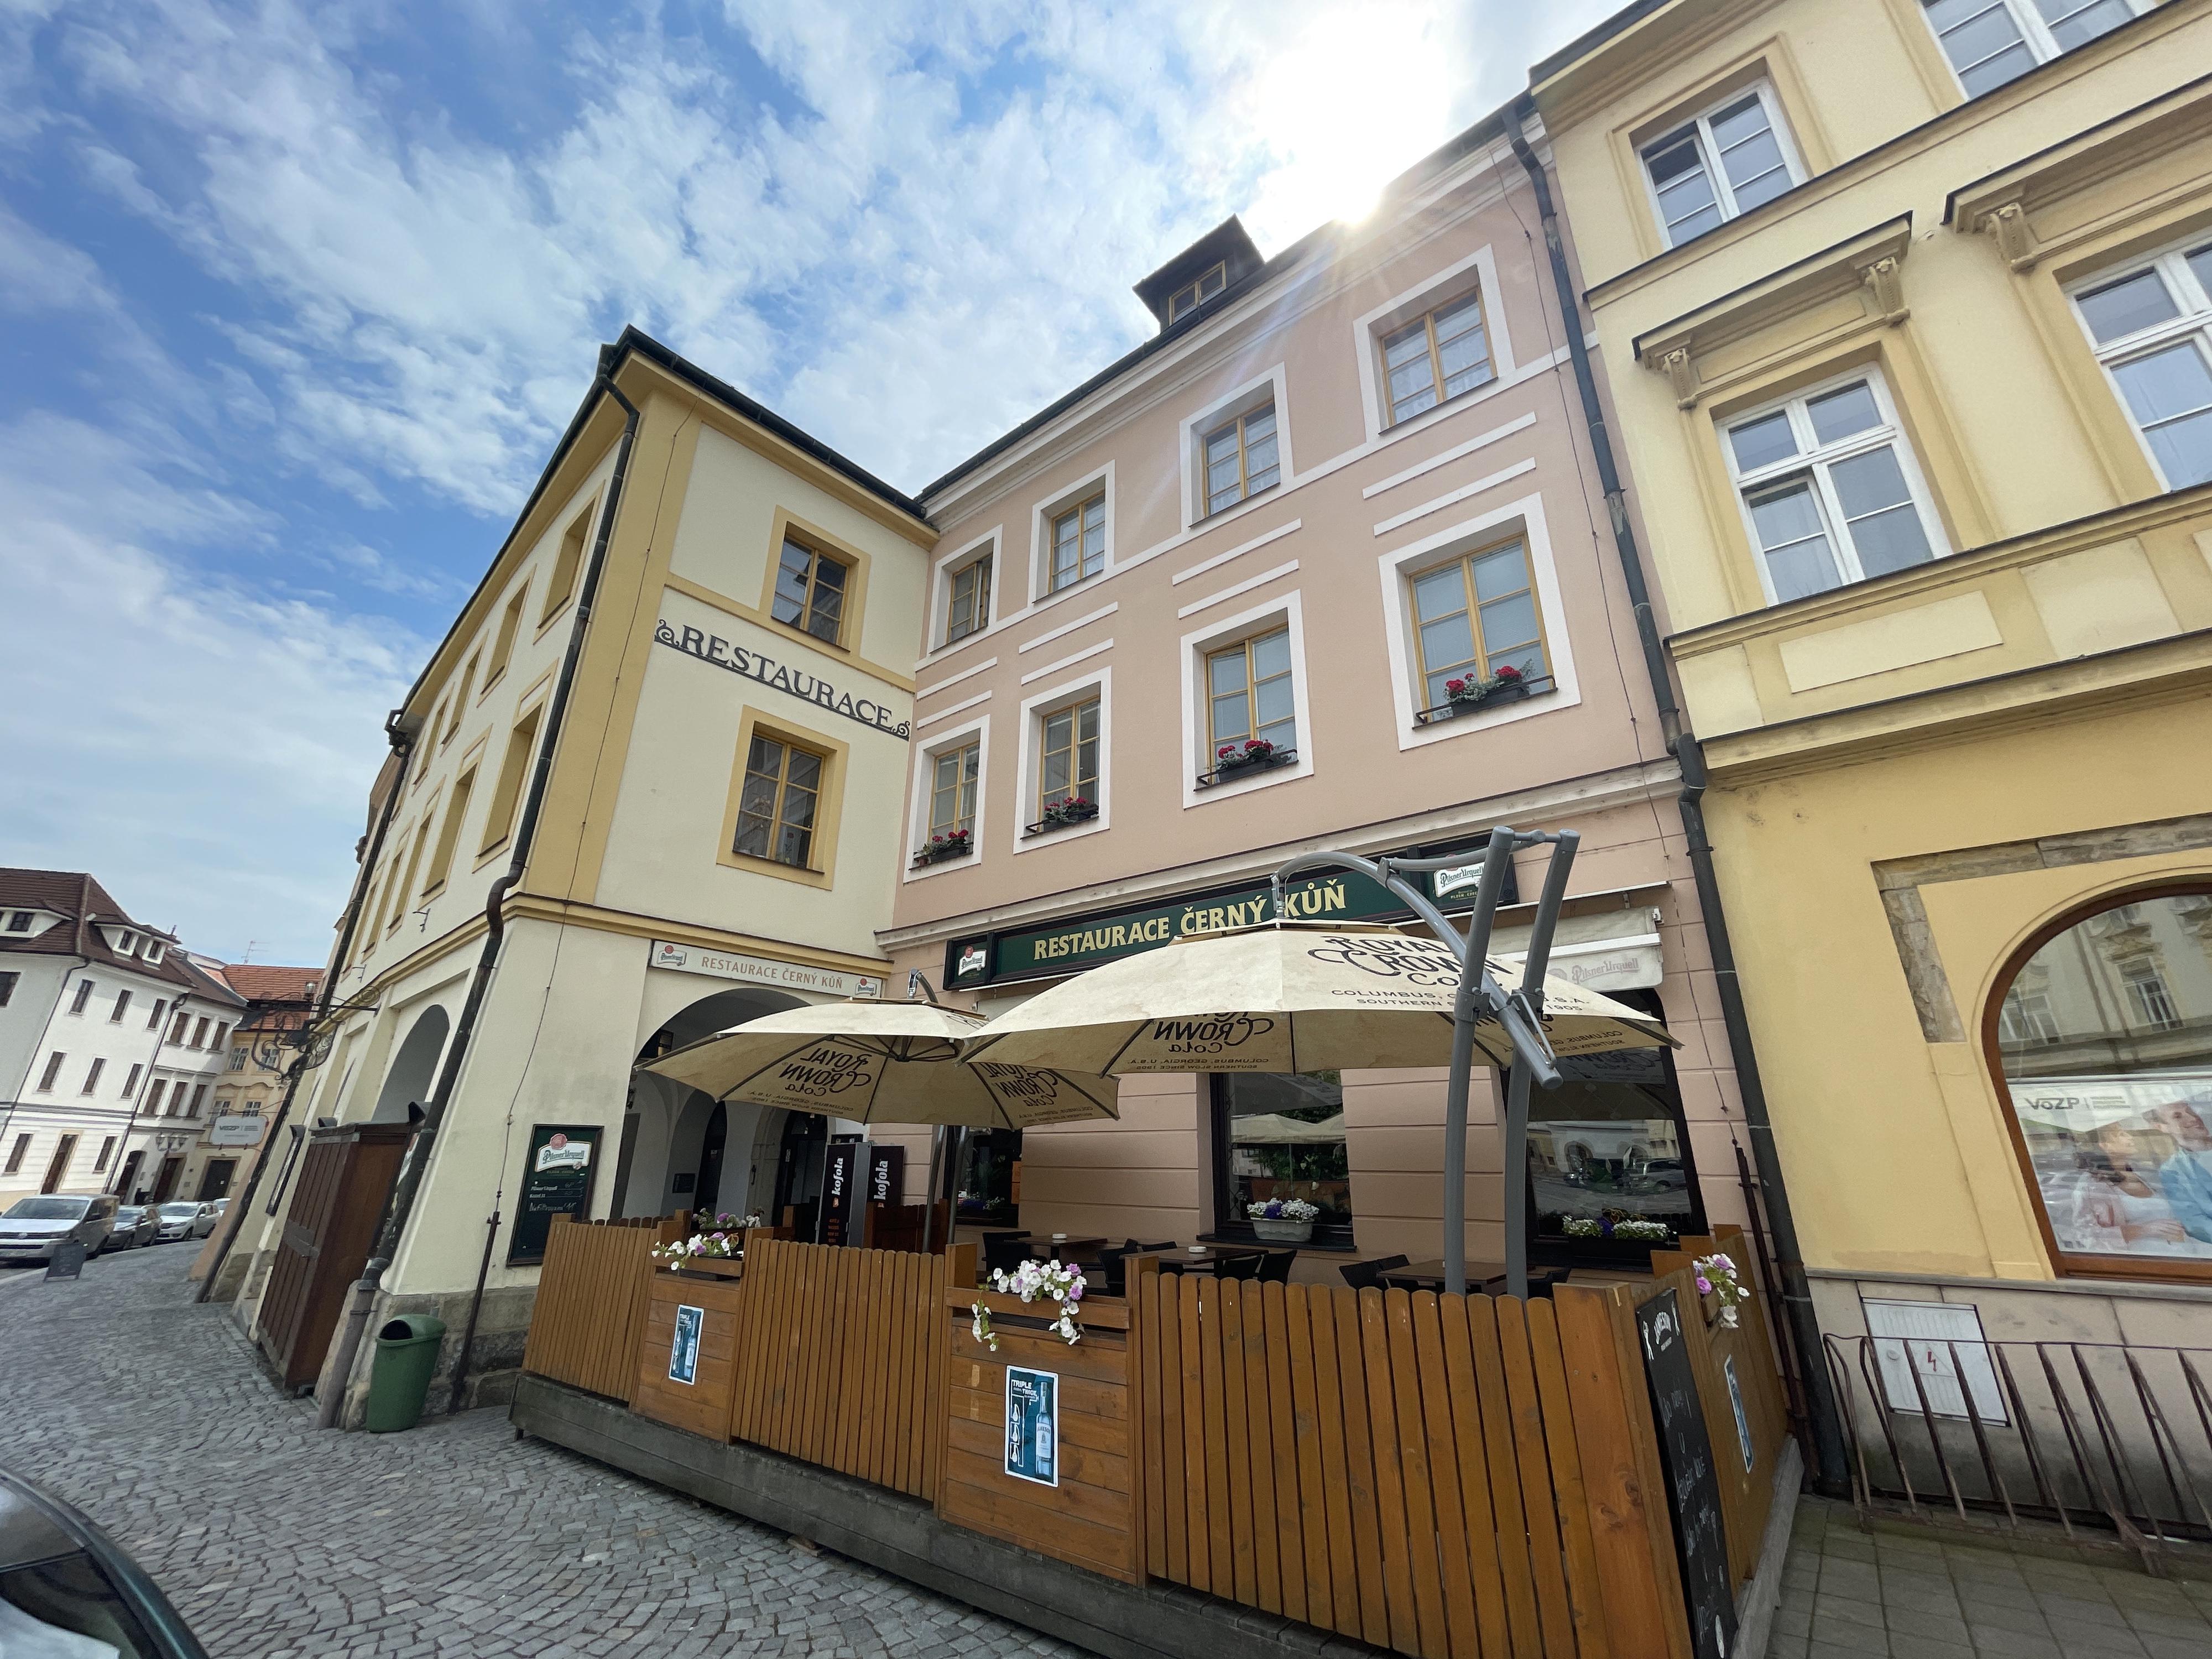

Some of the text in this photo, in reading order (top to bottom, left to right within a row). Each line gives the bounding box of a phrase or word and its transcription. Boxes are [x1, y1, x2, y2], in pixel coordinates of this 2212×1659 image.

[681, 624, 894, 731] RESTAURACE
[1440, 872, 1462, 888] Pilsner
[1034, 879, 1347, 961] RESTAURACE ČERNÝ KŮŇ
[701, 956, 778, 978] RESTAURACE
[782, 968, 818, 985] ČERNÝ
[1572, 958, 1639, 984] Pilsner Urquell
[1331, 989, 1443, 1000] COLUMBUS,
[1357, 998, 1448, 1006] SOUTHERN
[832, 1157, 844, 1196] kofola
[874, 1160, 890, 1200] kofola
[1012, 1379, 1032, 1389] TRIPLE
